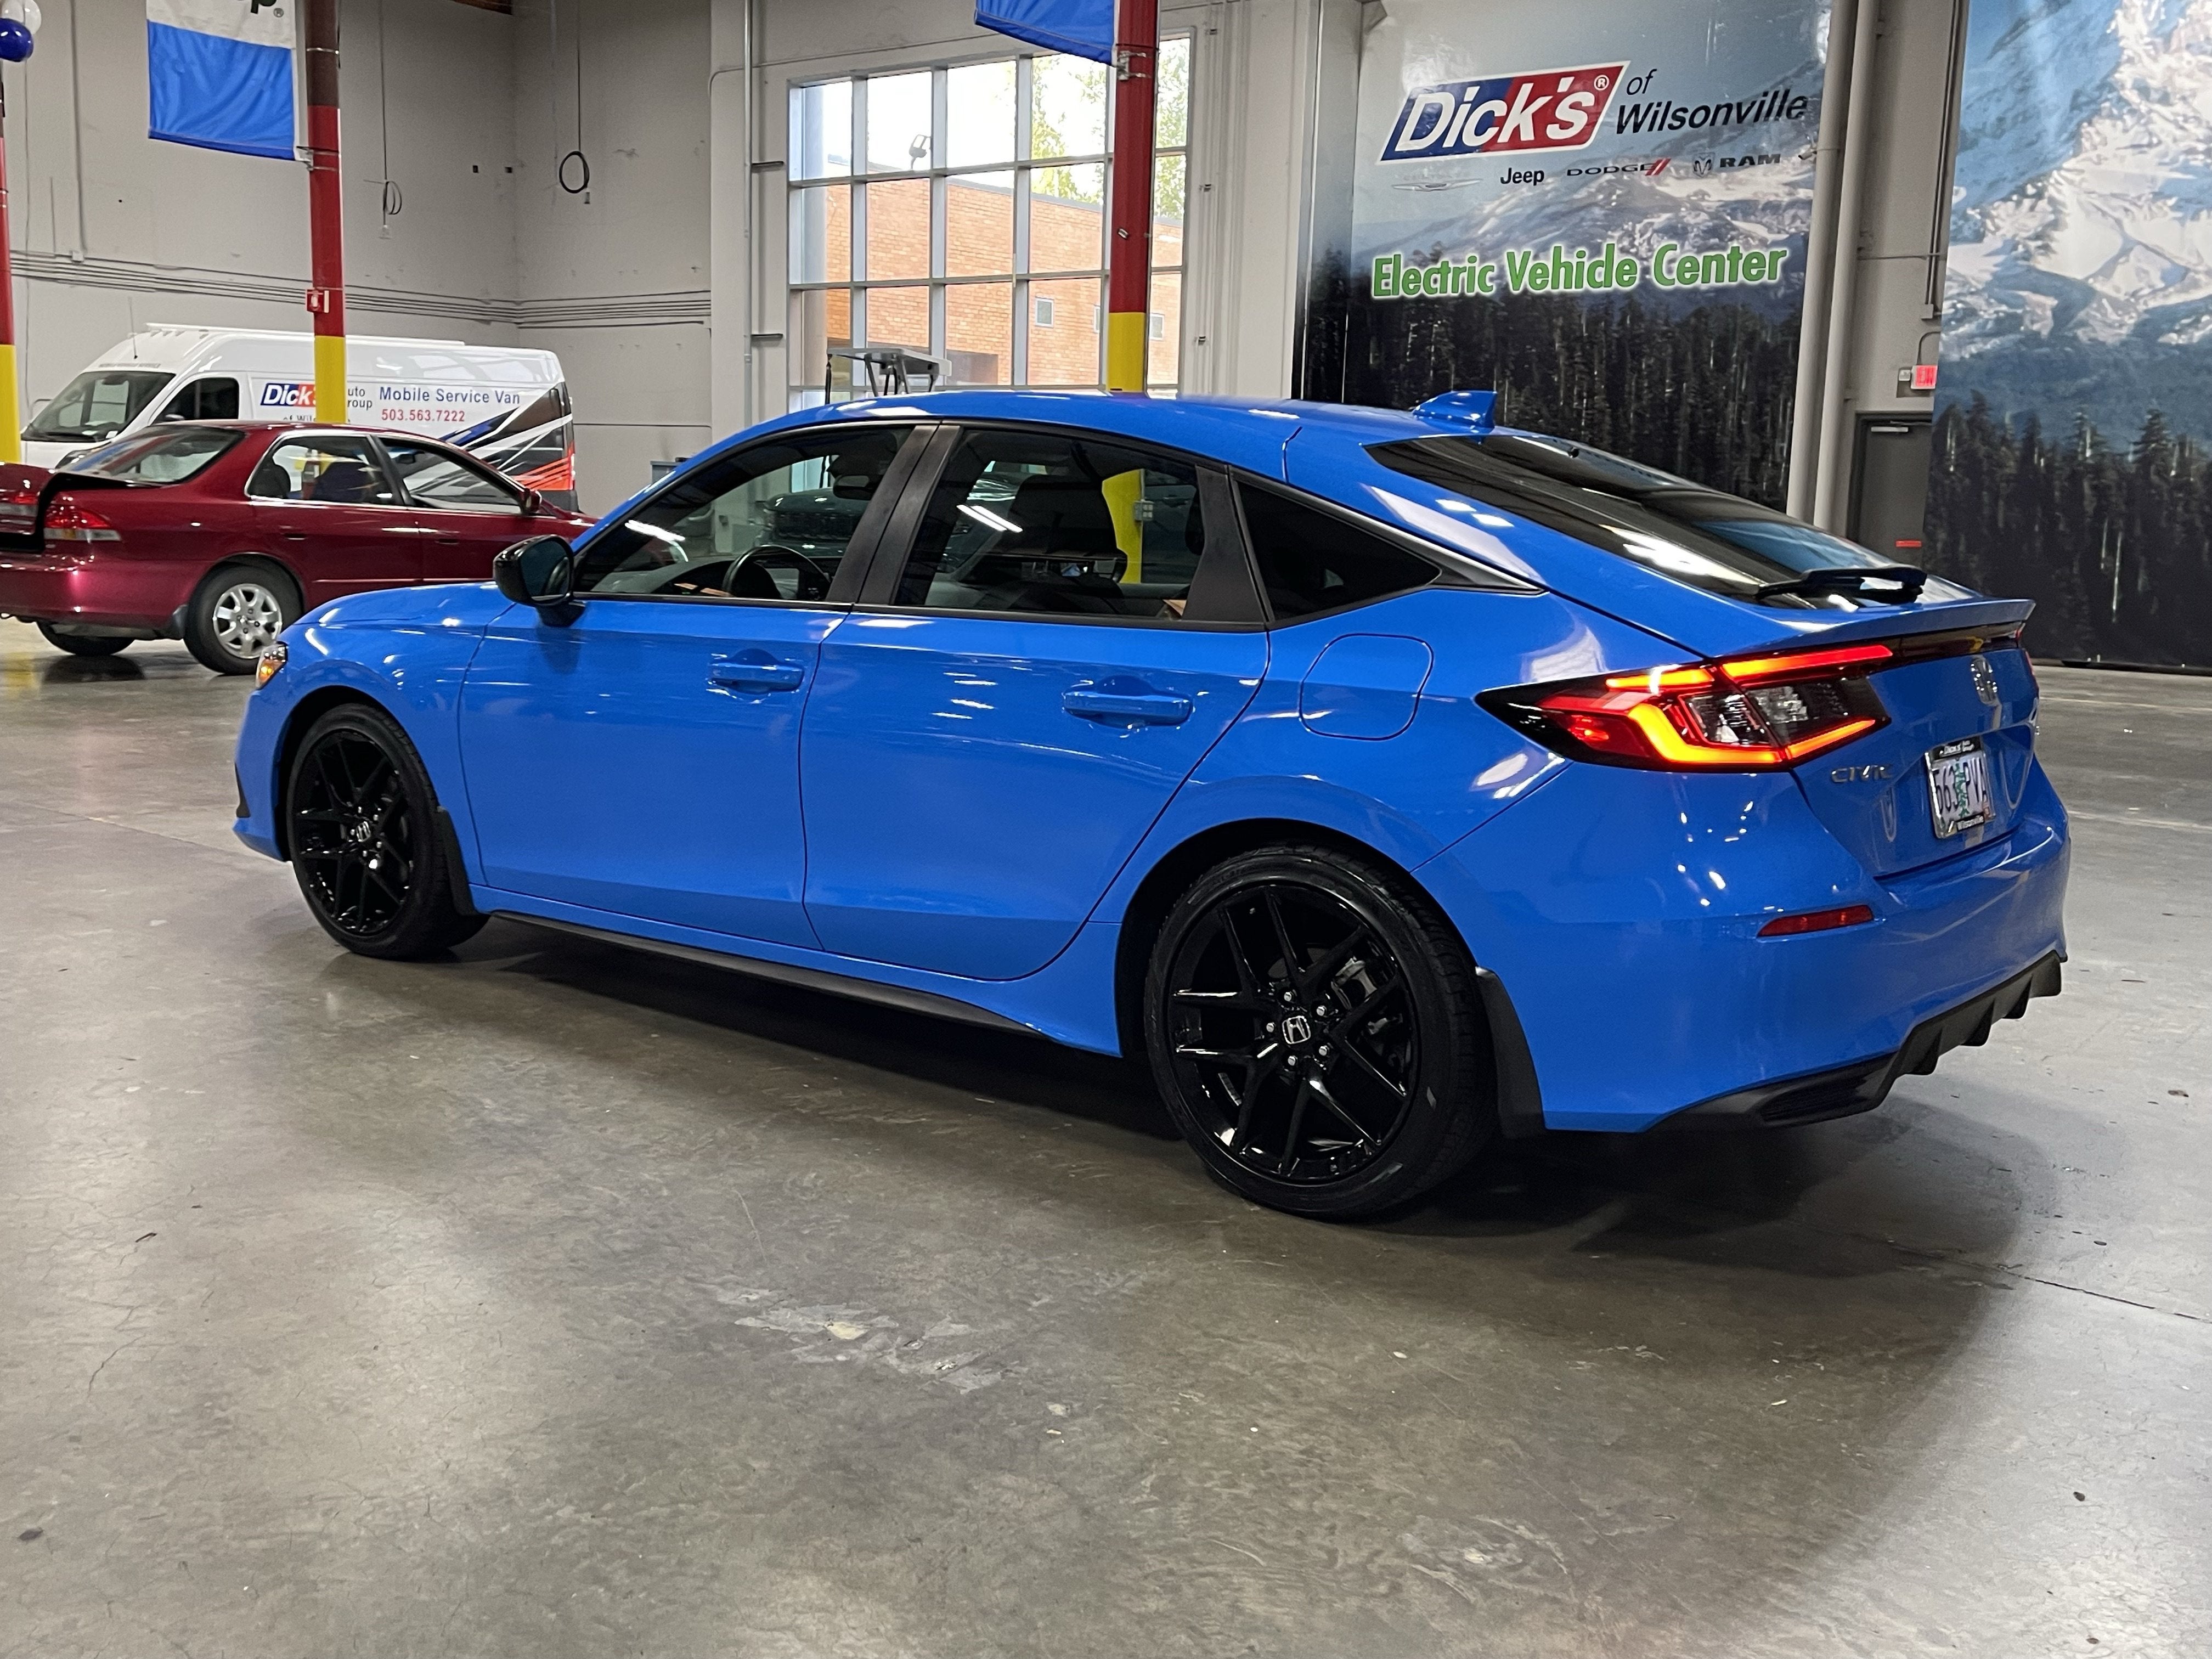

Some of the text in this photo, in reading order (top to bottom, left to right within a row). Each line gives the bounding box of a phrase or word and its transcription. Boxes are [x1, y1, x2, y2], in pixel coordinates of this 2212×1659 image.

[1627, 69, 1657, 95] of
[1616, 89, 1808, 134] Wilsonville
[1567, 162, 1653, 177] DODGE
[1720, 154, 1781, 168] RAM
[1500, 167, 1544, 186] Jeep
[1373, 243, 1787, 297] Electric Vehicle Center
[263, 384, 317, 405] Dick
[348, 386, 365, 397] uto
[380, 386, 520, 404] Mobile Service Van
[347, 399, 373, 410] roup
[381, 409, 465, 422] 503.563.7222
[1831, 765, 1893, 783] CIVIC
